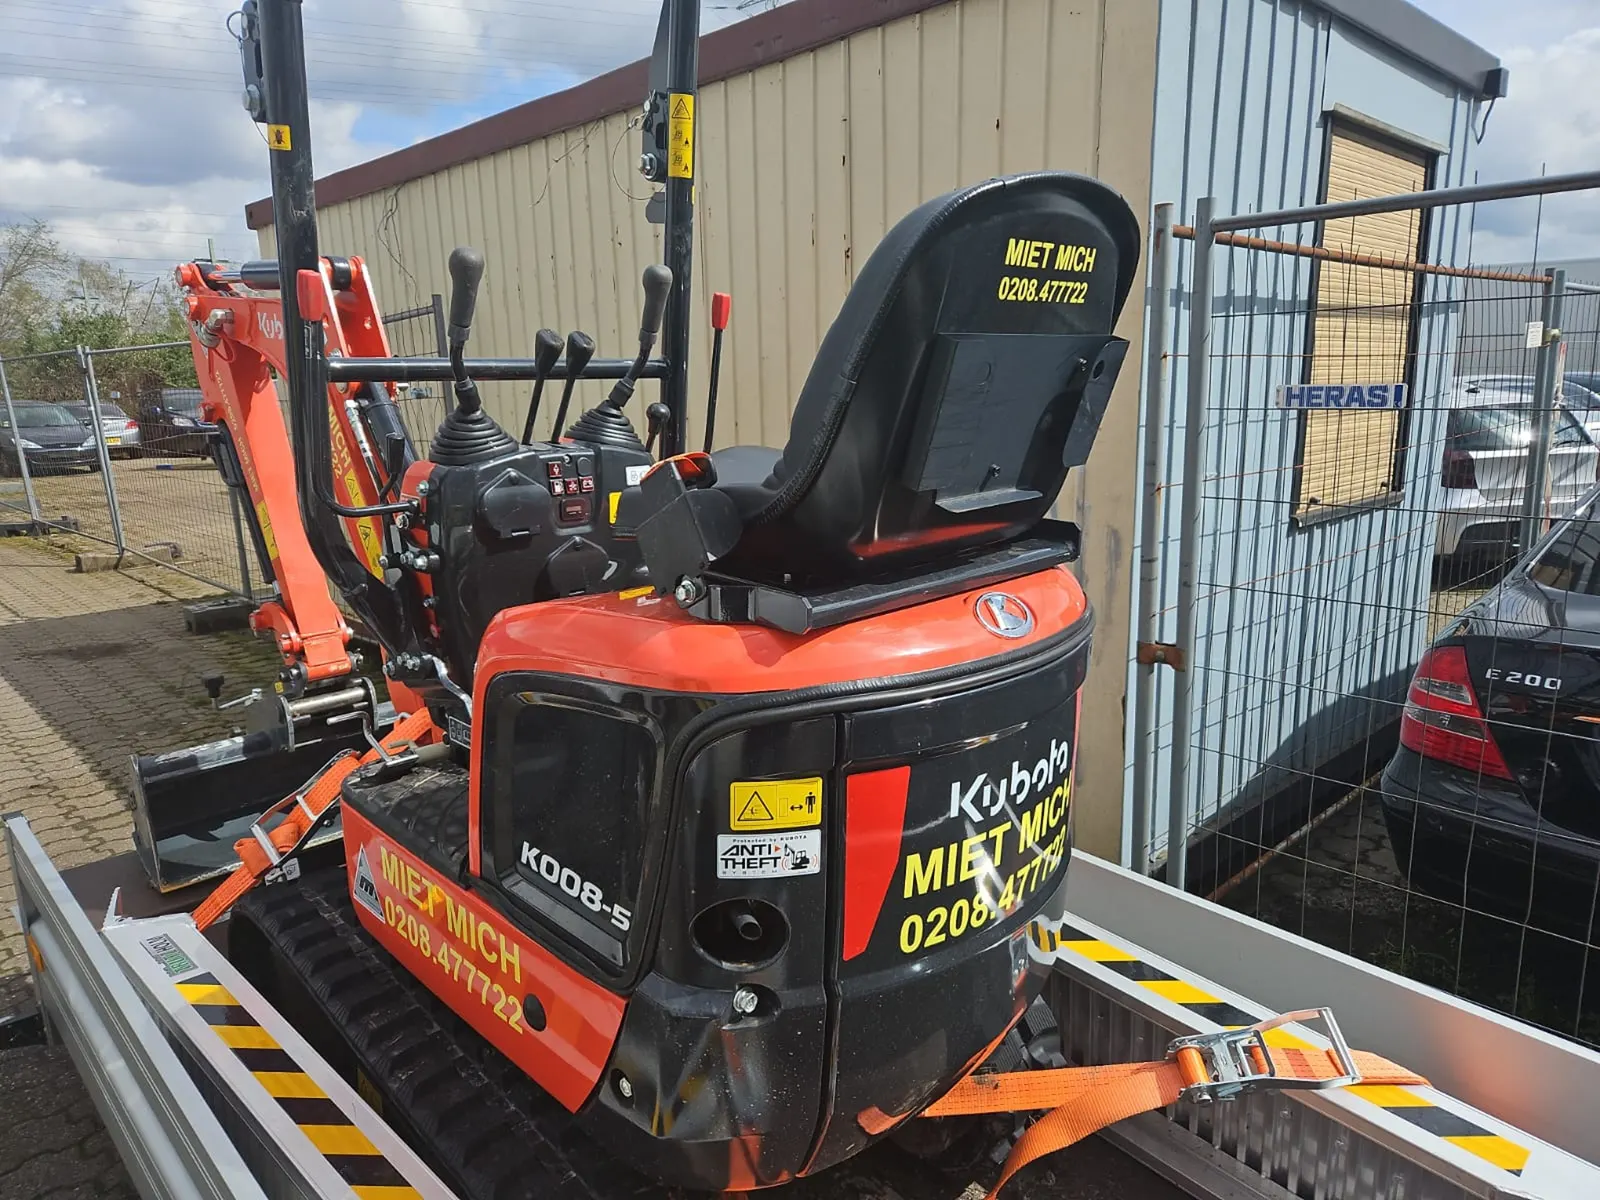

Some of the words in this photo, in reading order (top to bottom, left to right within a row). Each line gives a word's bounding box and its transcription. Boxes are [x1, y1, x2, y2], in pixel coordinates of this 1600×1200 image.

[1004, 238, 1055, 269] MIET
[1054, 244, 1097, 272] MICH
[998, 276, 1089, 304] 0208.477722
[257, 311, 285, 340] Kub
[1285, 384, 1389, 408] HERAS
[1485, 667, 1502, 680] E
[1505, 671, 1562, 690] 200
[949, 738, 1069, 824] Kubota
[721, 843, 772, 856] ANTI
[903, 820, 1012, 899] MIET
[1018, 768, 1073, 854] MICH
[720, 856, 782, 869] THEFT
[520, 840, 632, 932] K008-5
[899, 824, 1067, 954] 0208.477722
[380, 845, 442, 919] MIET
[445, 894, 521, 985] MICH
[383, 895, 524, 1035] 0208.477722
